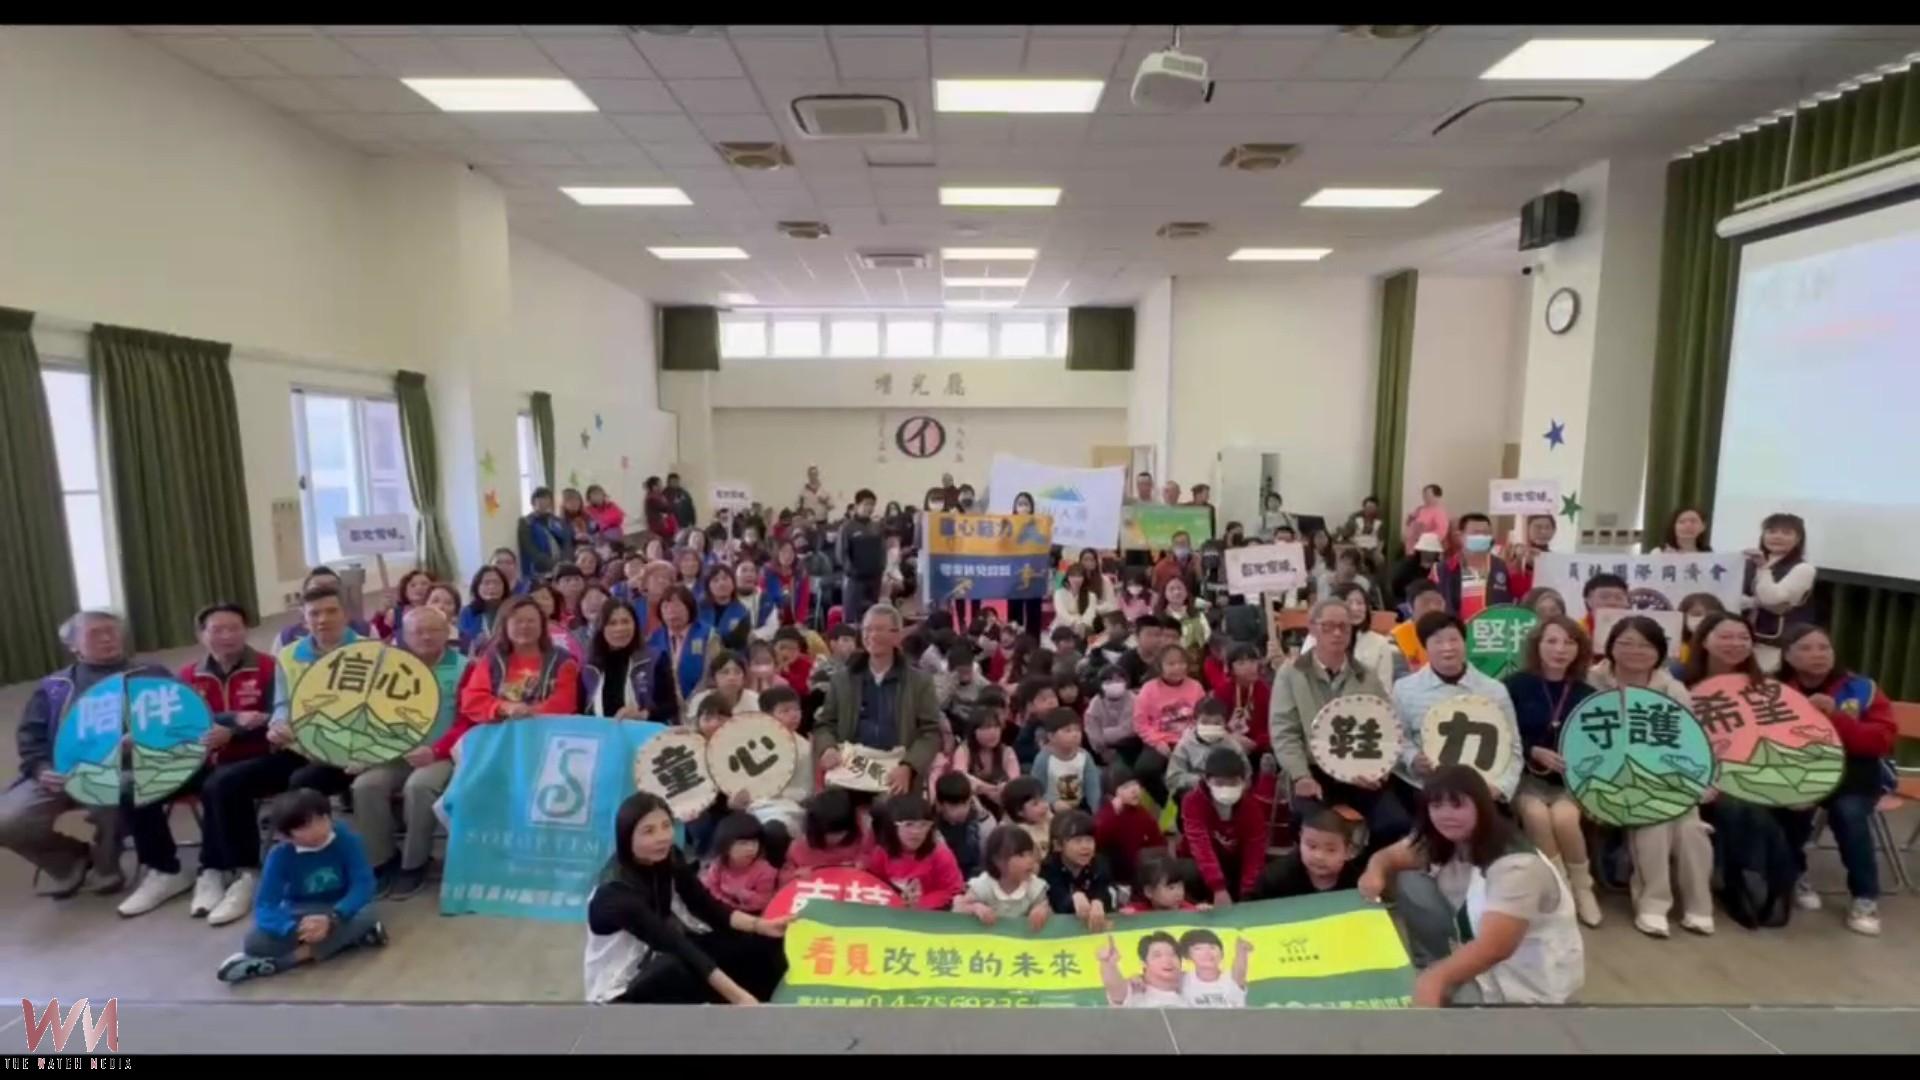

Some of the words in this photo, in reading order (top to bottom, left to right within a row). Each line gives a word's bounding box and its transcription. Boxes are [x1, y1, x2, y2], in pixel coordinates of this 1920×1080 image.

[328, 651, 421, 700] 信心
[76, 684, 183, 740] 陪伴
[1580, 701, 1683, 749] 守護
[1691, 678, 1800, 735] 希望
[728, 735, 779, 777] 心
[1329, 715, 1383, 759] 鞋
[1438, 711, 1499, 772] 力
[652, 745, 705, 799] 童
[802, 936, 1082, 978] 看見改變的未來
